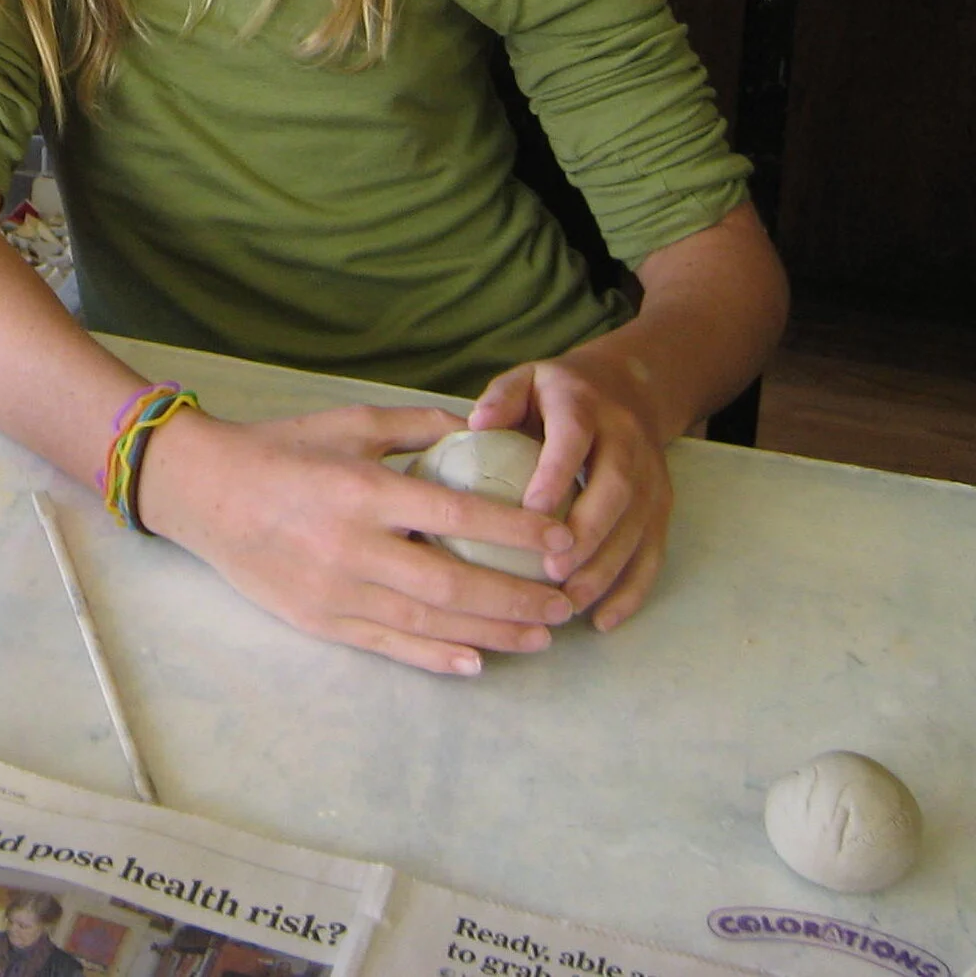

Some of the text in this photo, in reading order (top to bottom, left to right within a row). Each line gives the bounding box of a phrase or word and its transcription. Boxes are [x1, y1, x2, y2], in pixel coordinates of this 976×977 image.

[27, 839, 114, 874] pose
[120, 856, 239, 918] health
[246, 904, 348, 947] risk?
[446, 941, 476, 965] to
[558, 950, 624, 977] able
[717, 914, 942, 977] COLORATIONS
